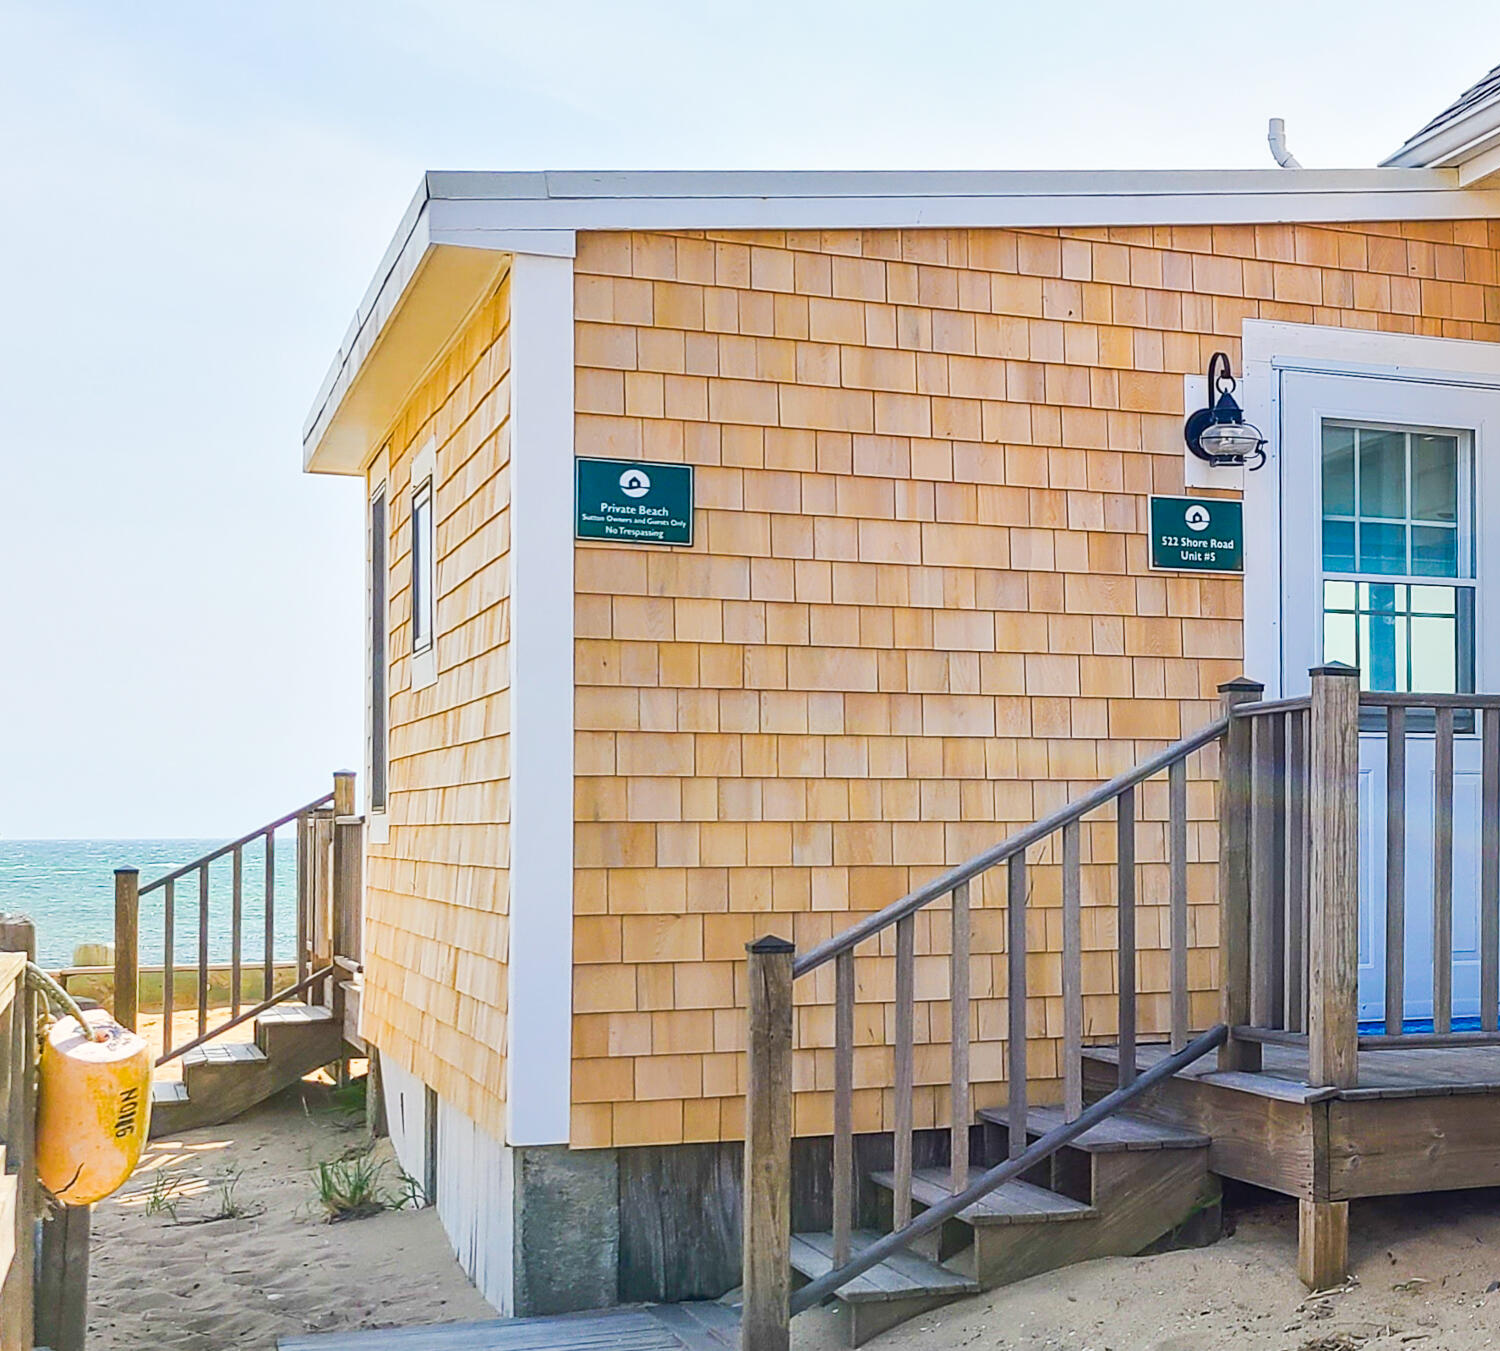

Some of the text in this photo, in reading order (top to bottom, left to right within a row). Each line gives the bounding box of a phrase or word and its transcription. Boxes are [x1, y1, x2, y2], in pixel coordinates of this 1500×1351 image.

[600, 502, 669, 516] Private Beach
[670, 519, 687, 528] Only
[605, 525, 664, 539] No Trespassing
[1161, 536, 1234, 549] 522 Shore Road
[1180, 551, 1216, 562] Unit #5
